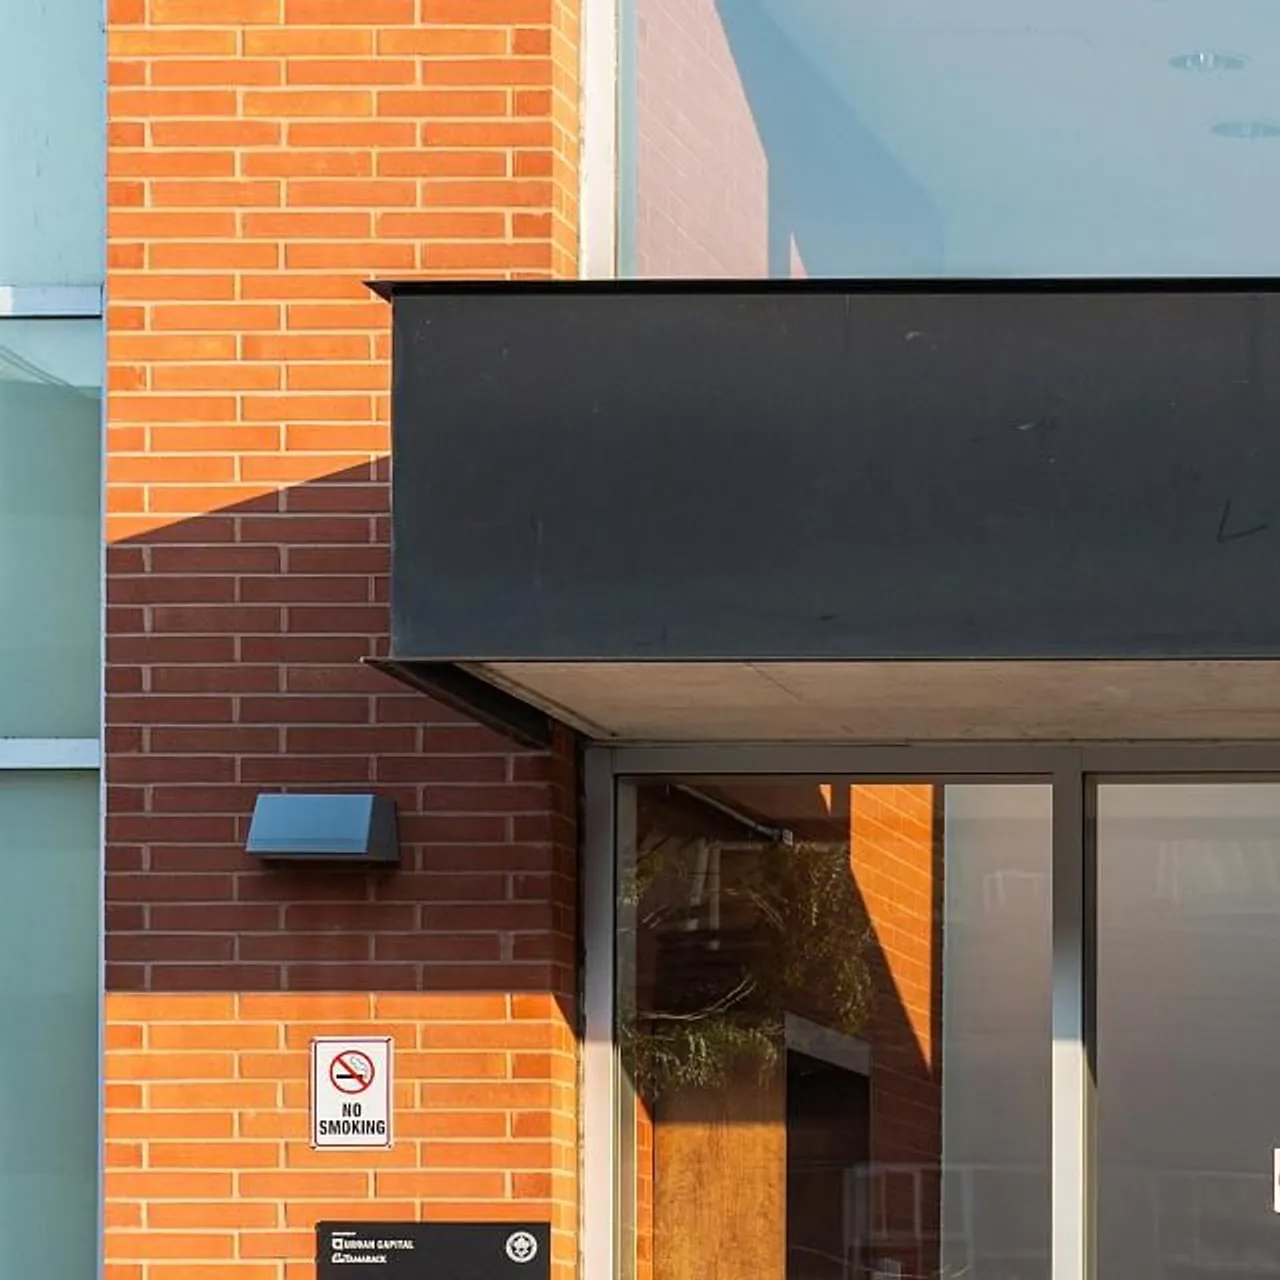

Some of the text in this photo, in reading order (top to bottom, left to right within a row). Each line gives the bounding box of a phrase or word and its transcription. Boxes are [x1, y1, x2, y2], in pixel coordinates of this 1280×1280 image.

[342, 1102, 362, 1118] NO
[319, 1119, 386, 1135] SMOKING
[376, 1239, 415, 1250] CAPITAL
